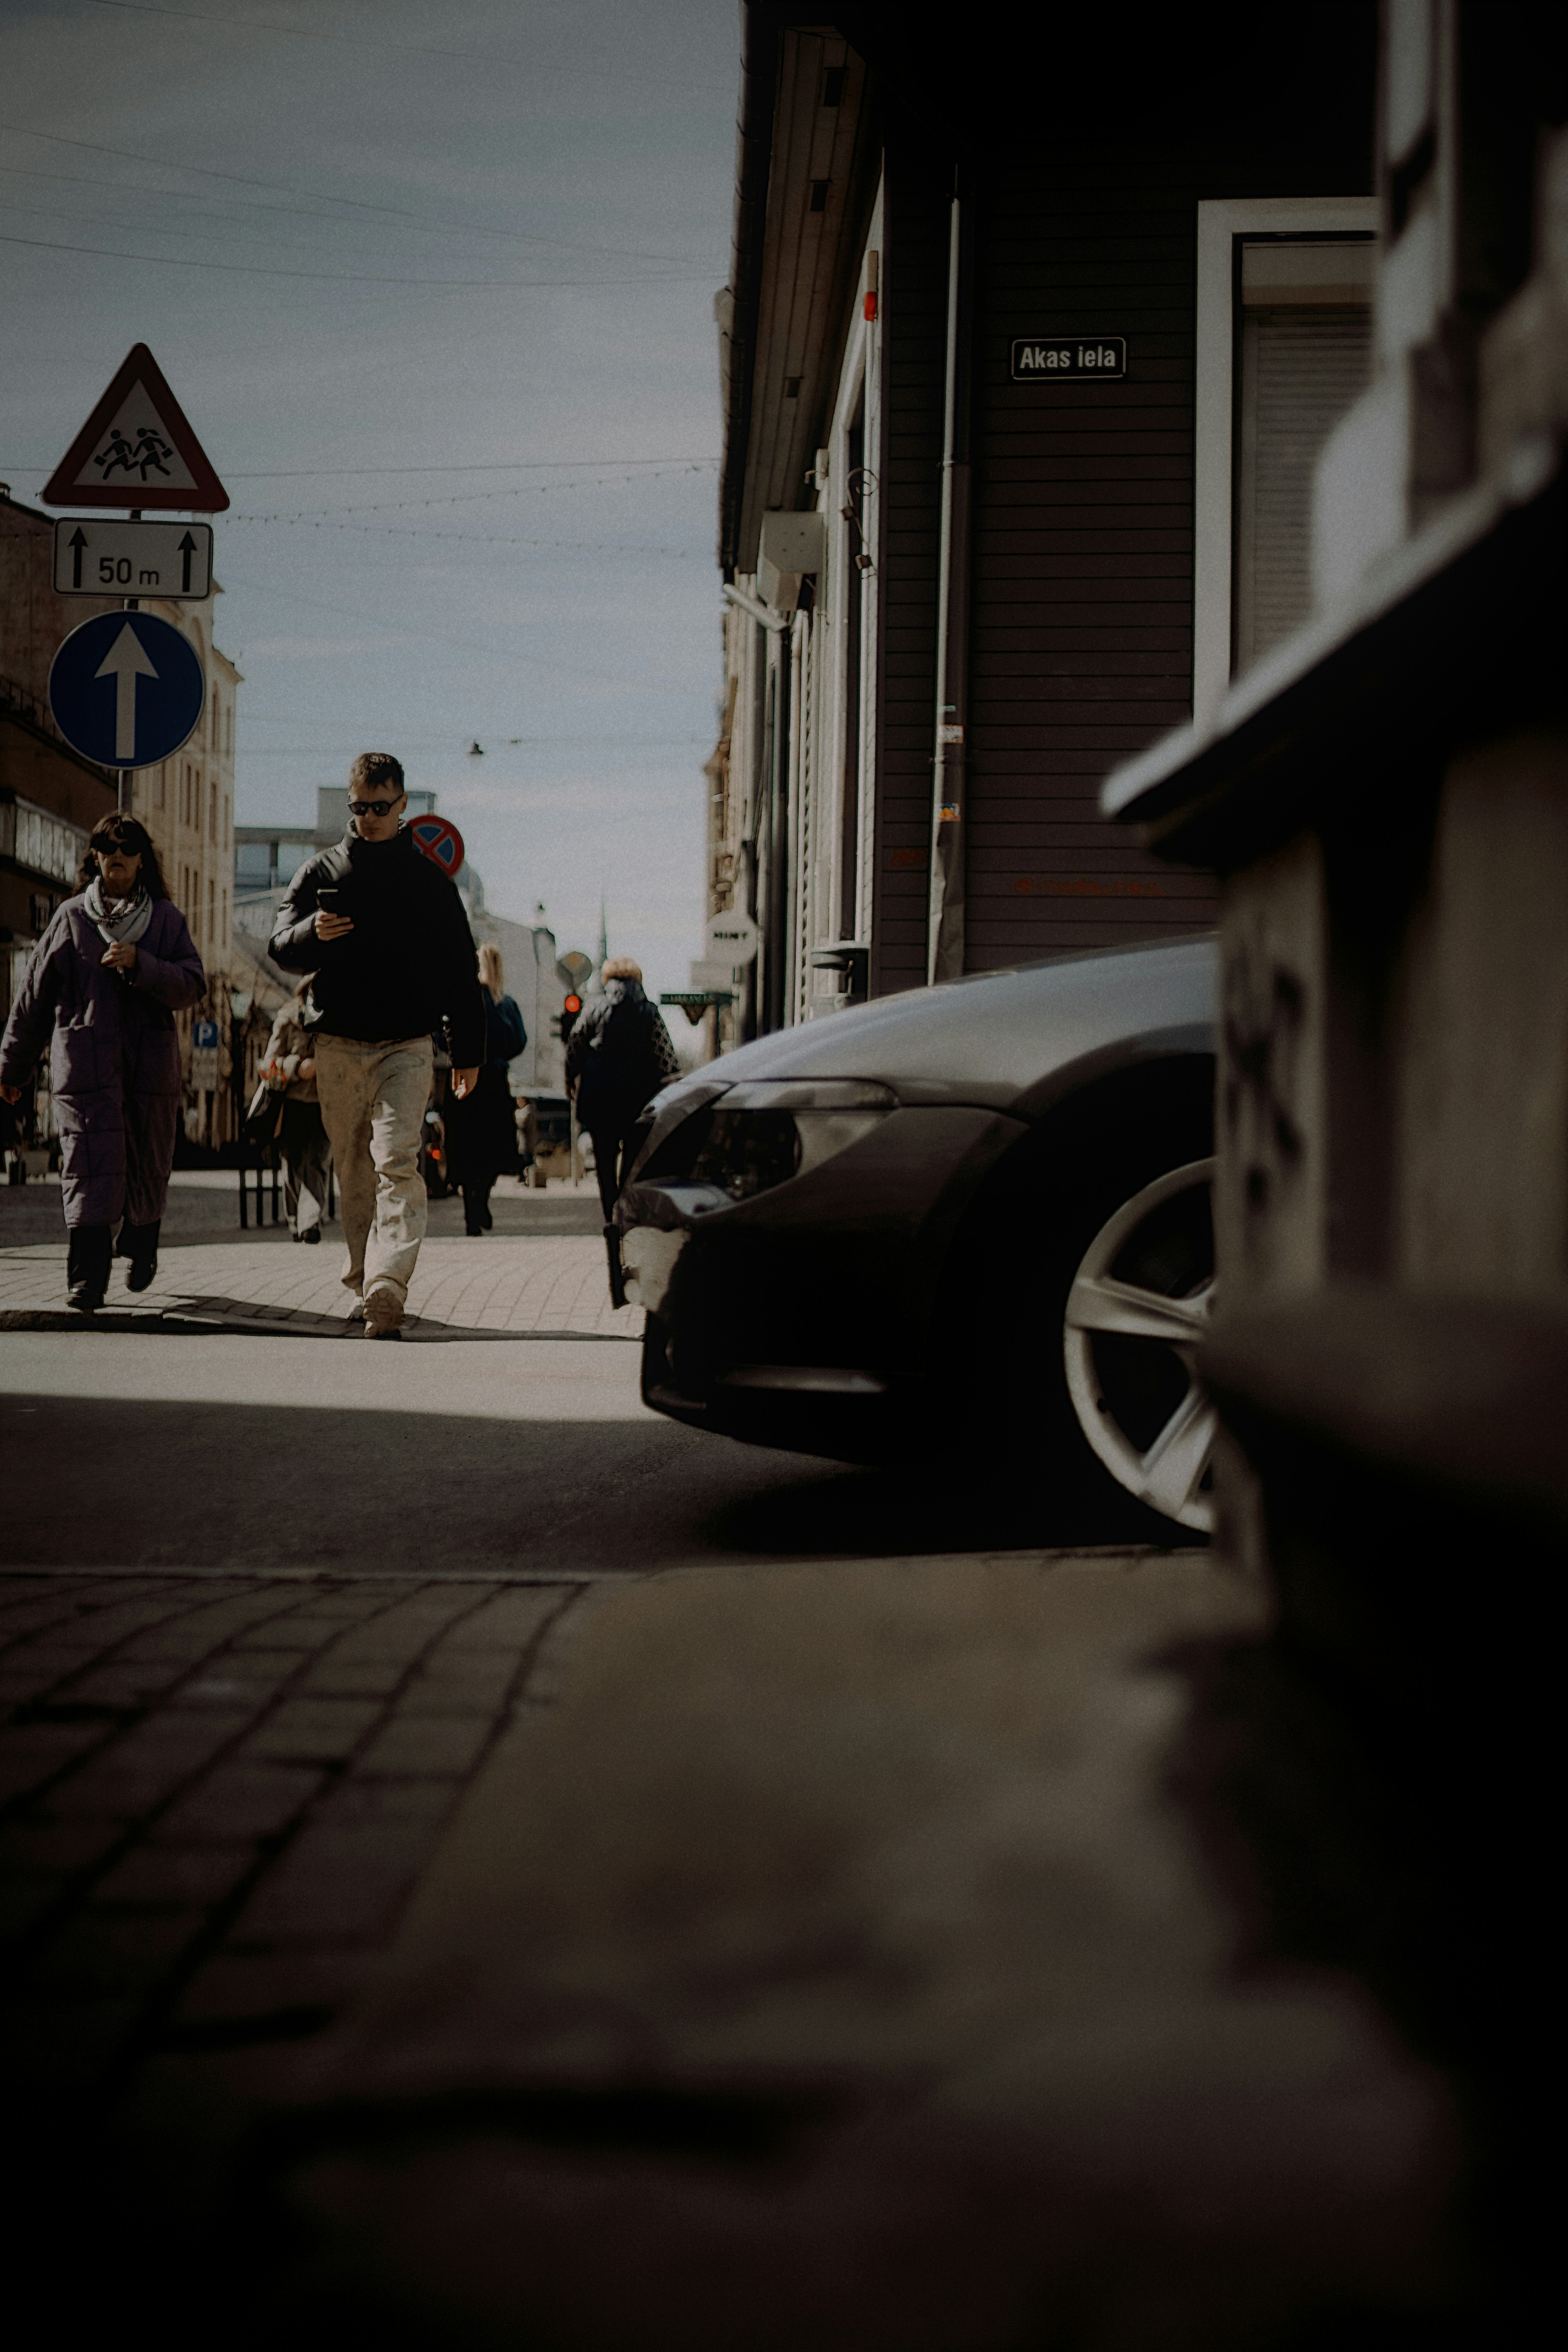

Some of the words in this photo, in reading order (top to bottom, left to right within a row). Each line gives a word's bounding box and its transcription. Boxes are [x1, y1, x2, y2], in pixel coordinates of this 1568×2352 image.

[1019, 347, 1071, 368] Akas
[1078, 345, 1116, 368] iela
[100, 557, 131, 584] 50
[140, 570, 159, 585] m
[198, 1022, 212, 1046] P
